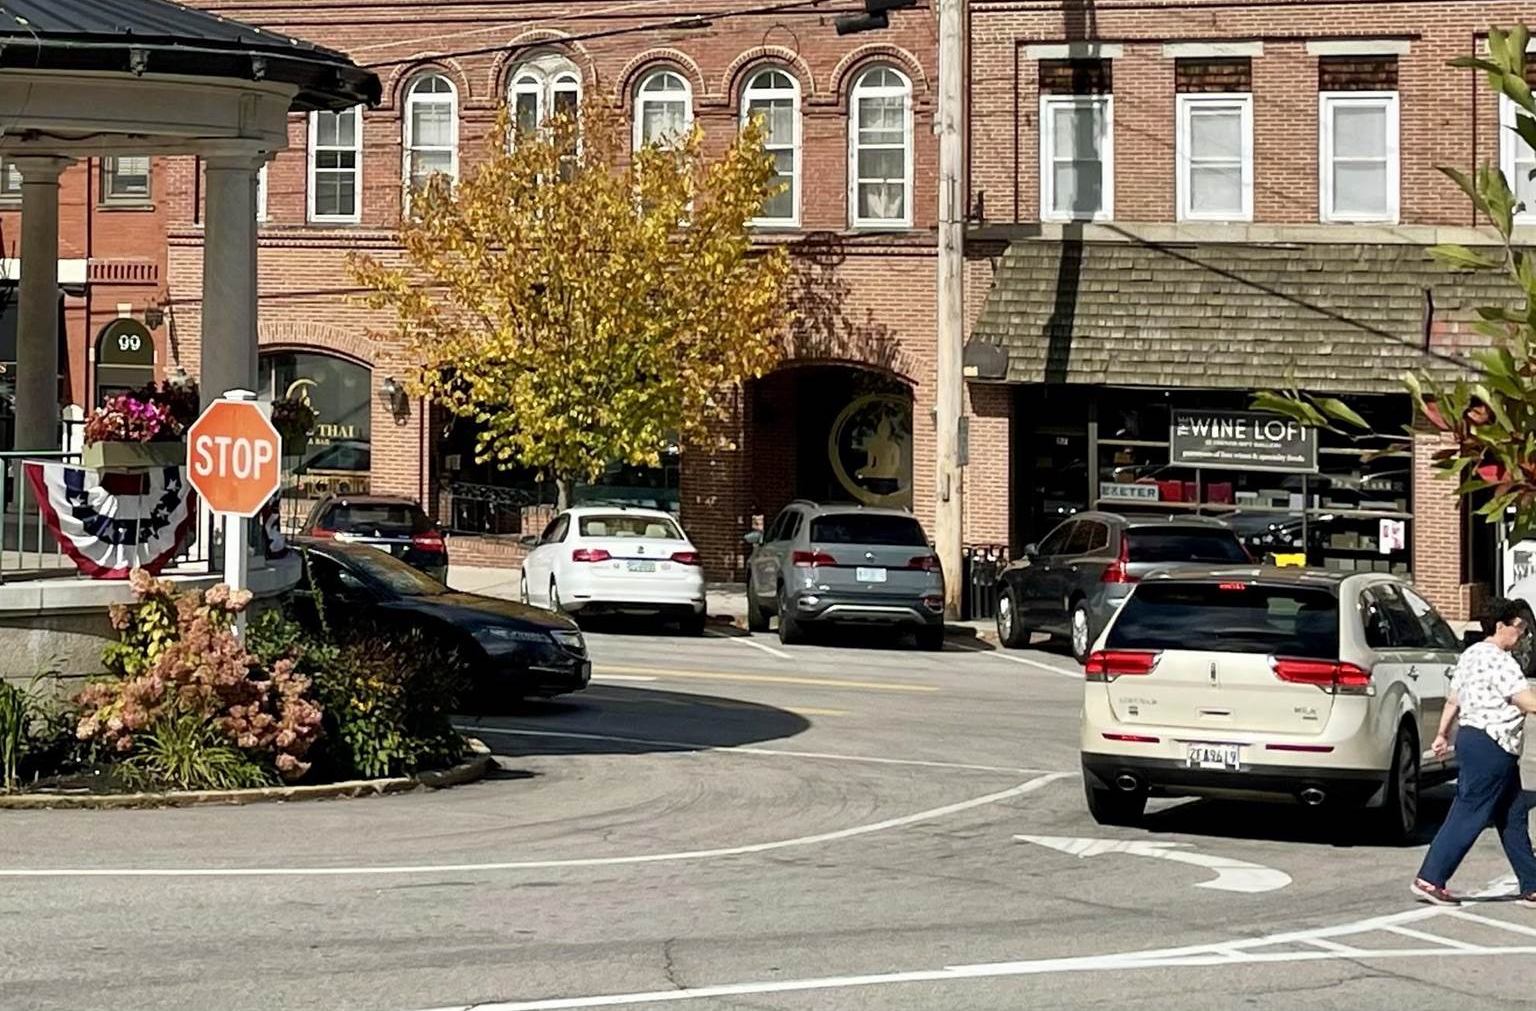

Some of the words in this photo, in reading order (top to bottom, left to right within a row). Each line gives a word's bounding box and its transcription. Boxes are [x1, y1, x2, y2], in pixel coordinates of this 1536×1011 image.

[118, 334, 141, 351] 99
[317, 423, 355, 439] THAI
[1190, 416, 1247, 439] WINE
[194, 435, 273, 480] STOP
[1101, 485, 1156, 498] EXETER
